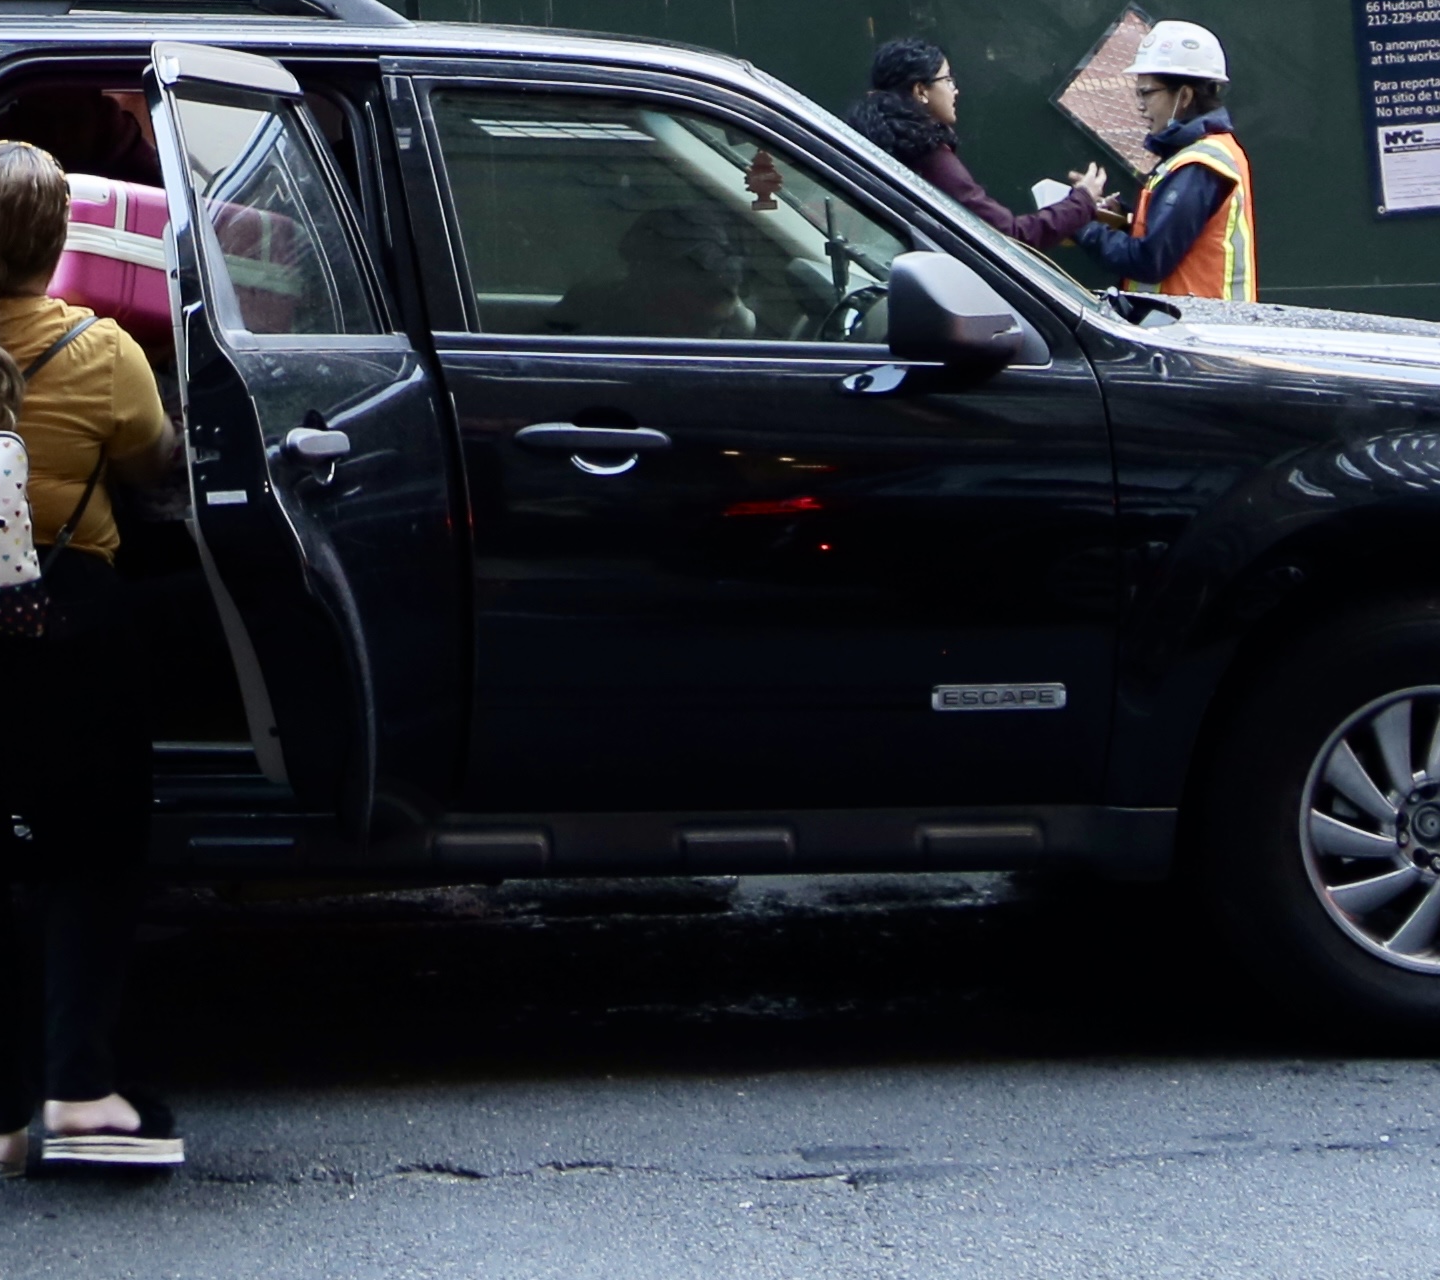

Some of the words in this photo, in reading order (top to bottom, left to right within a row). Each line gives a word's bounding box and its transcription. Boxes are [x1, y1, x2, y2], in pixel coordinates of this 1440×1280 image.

[1366, 1, 1380, 13] 66
[1382, 0, 1425, 11] Hudson
[1370, 41, 1383, 52] To
[1371, 56, 1383, 65] at
[1385, 52, 1405, 64] this
[1374, 80, 1398, 91] Para
[1375, 95, 1390, 105] un
[1392, 91, 1415, 104] sitio
[1417, 90, 1432, 101] de
[1376, 107, 1393, 117] No
[1395, 105, 1423, 116] tiene
[1384, 129, 1424, 146] NYC
[943, 690, 1054, 705] ESCAPE
